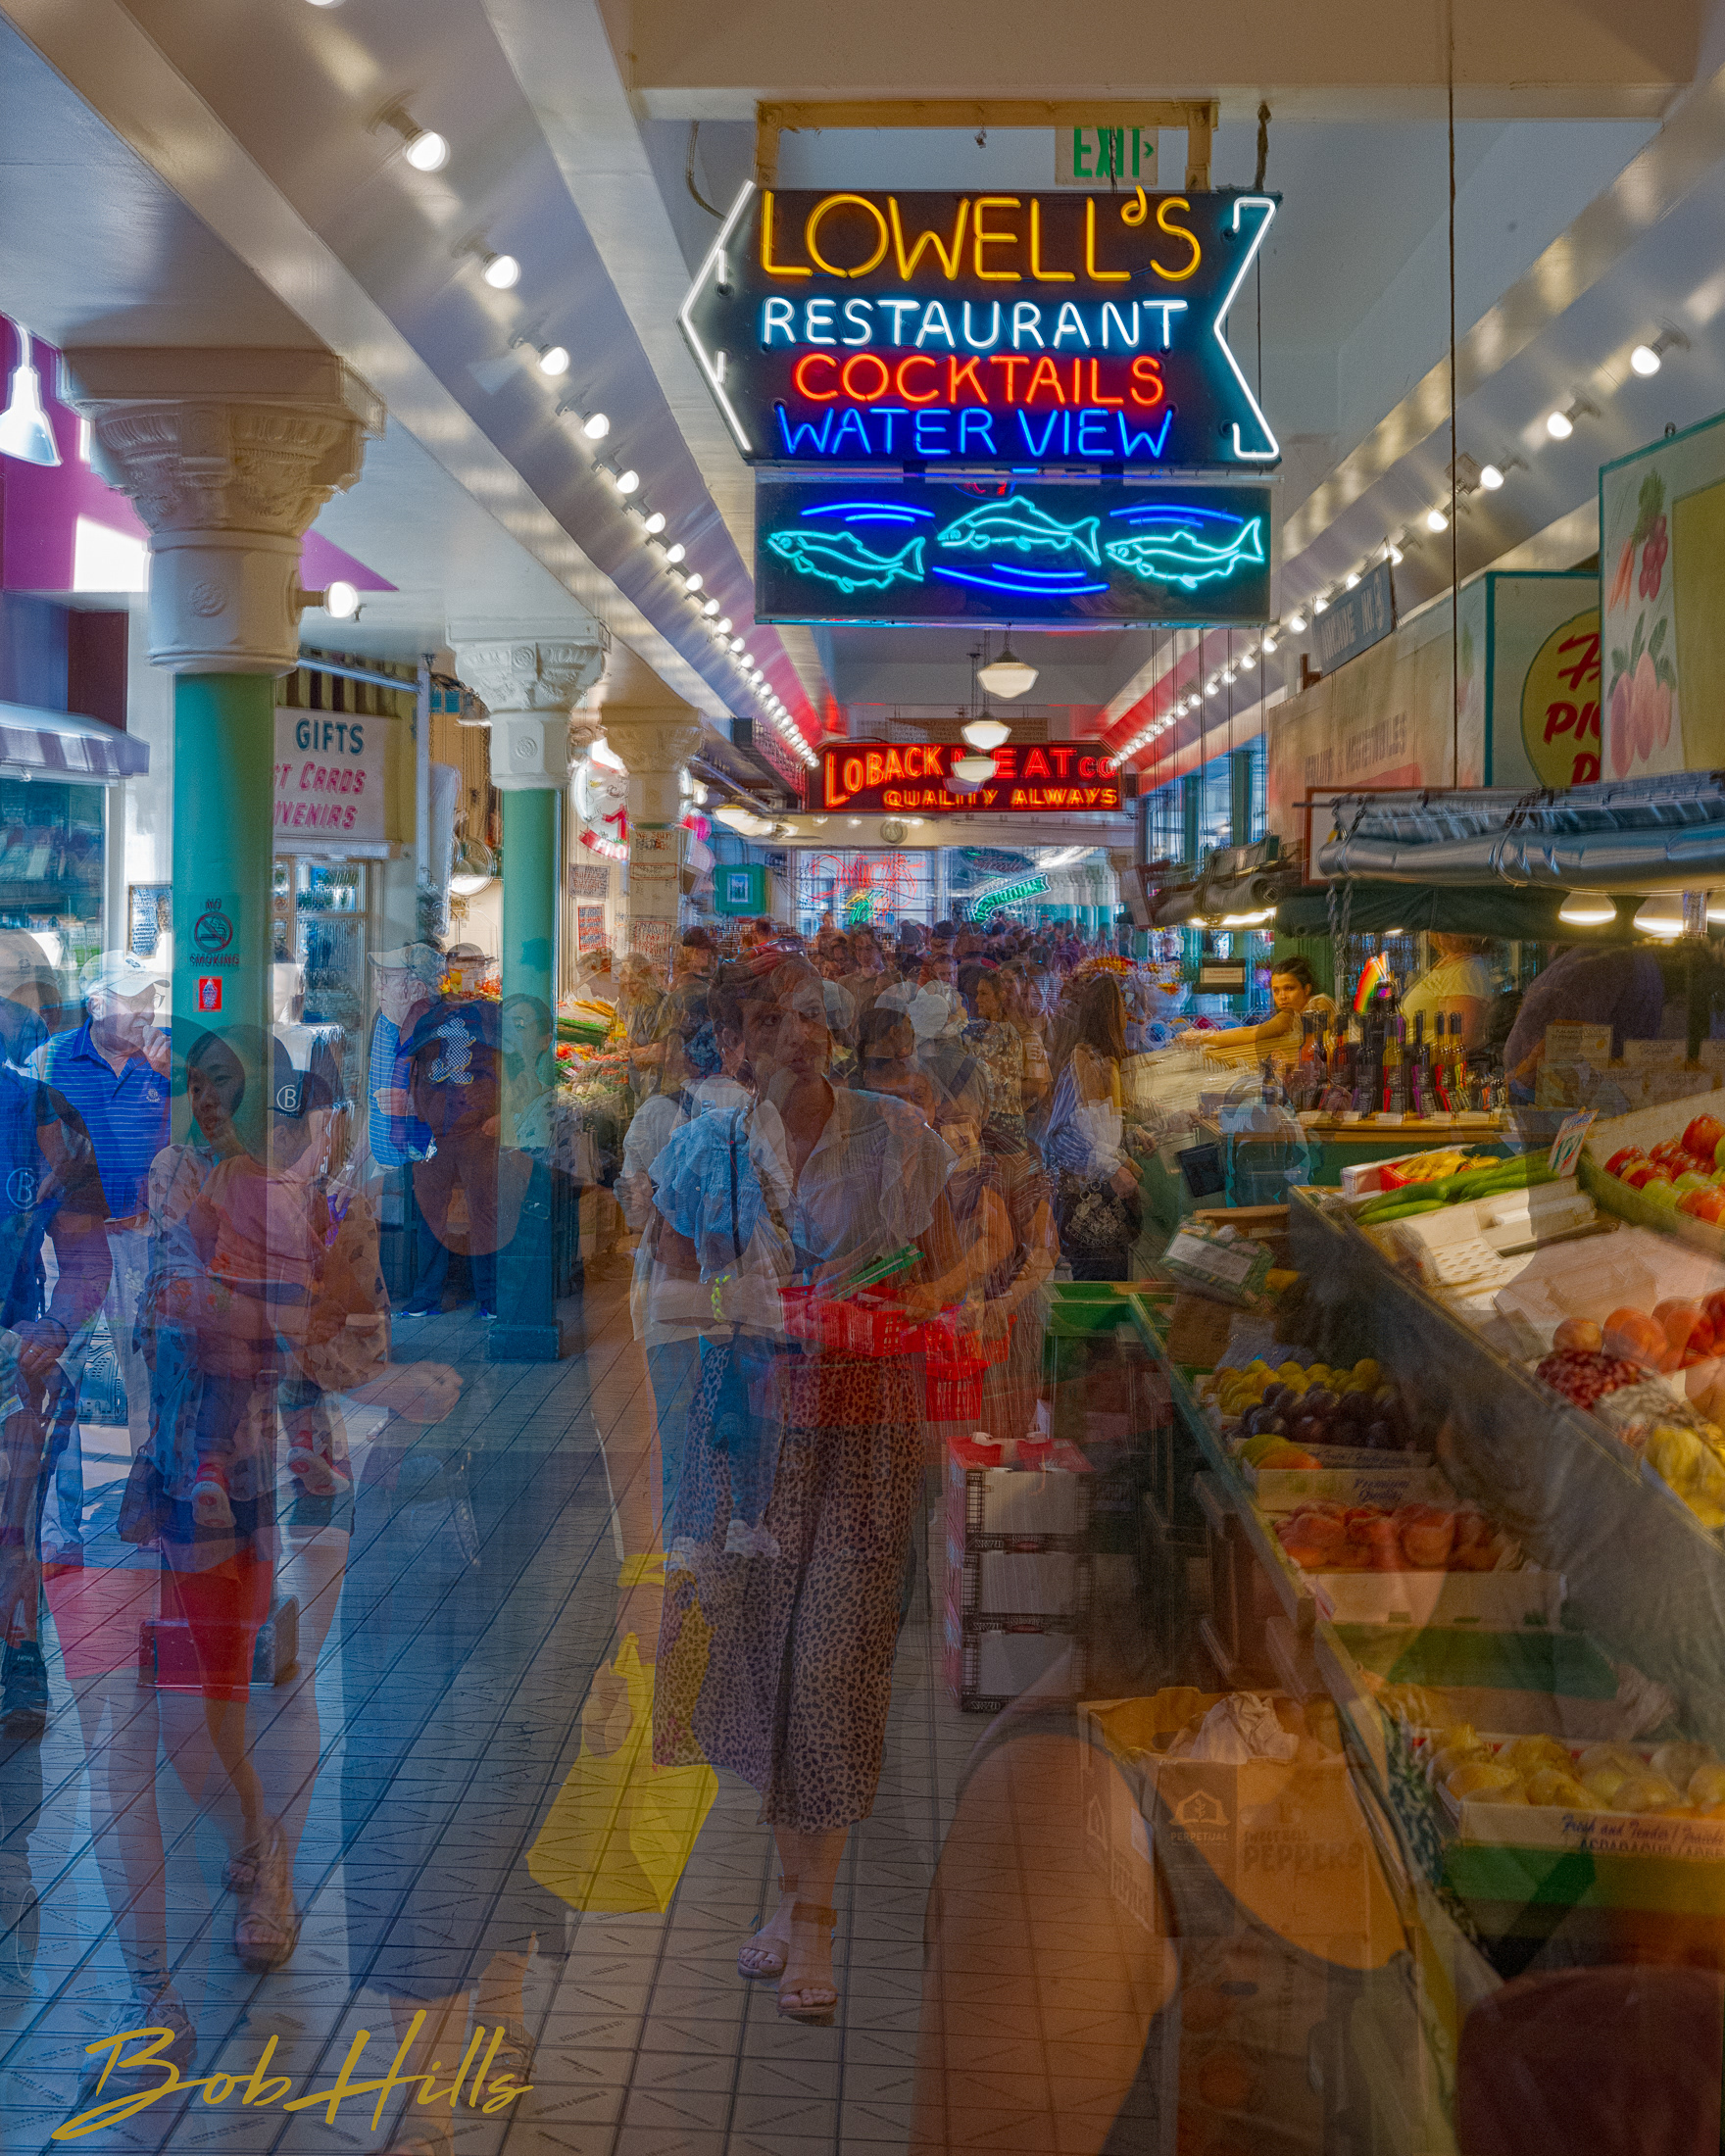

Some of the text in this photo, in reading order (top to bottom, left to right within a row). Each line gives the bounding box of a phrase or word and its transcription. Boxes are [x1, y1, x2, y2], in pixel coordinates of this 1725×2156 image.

[1074, 125, 1145, 177] EXIT
[761, 186, 1201, 280] LOWELL'S
[763, 297, 1188, 349] RESTAURANT
[793, 355, 1163, 404] COCKTAILS
[776, 405, 1172, 458] WATER VIEW
[296, 718, 364, 755] GIFTS
[1011, 788, 1117, 808] ALWAYS
[205, 899, 222, 911] NO
[189, 953, 240, 967] SMOKING
[1170, 1832, 1229, 1841] PERPETUAL
[1601, 1818, 1625, 1836] and
